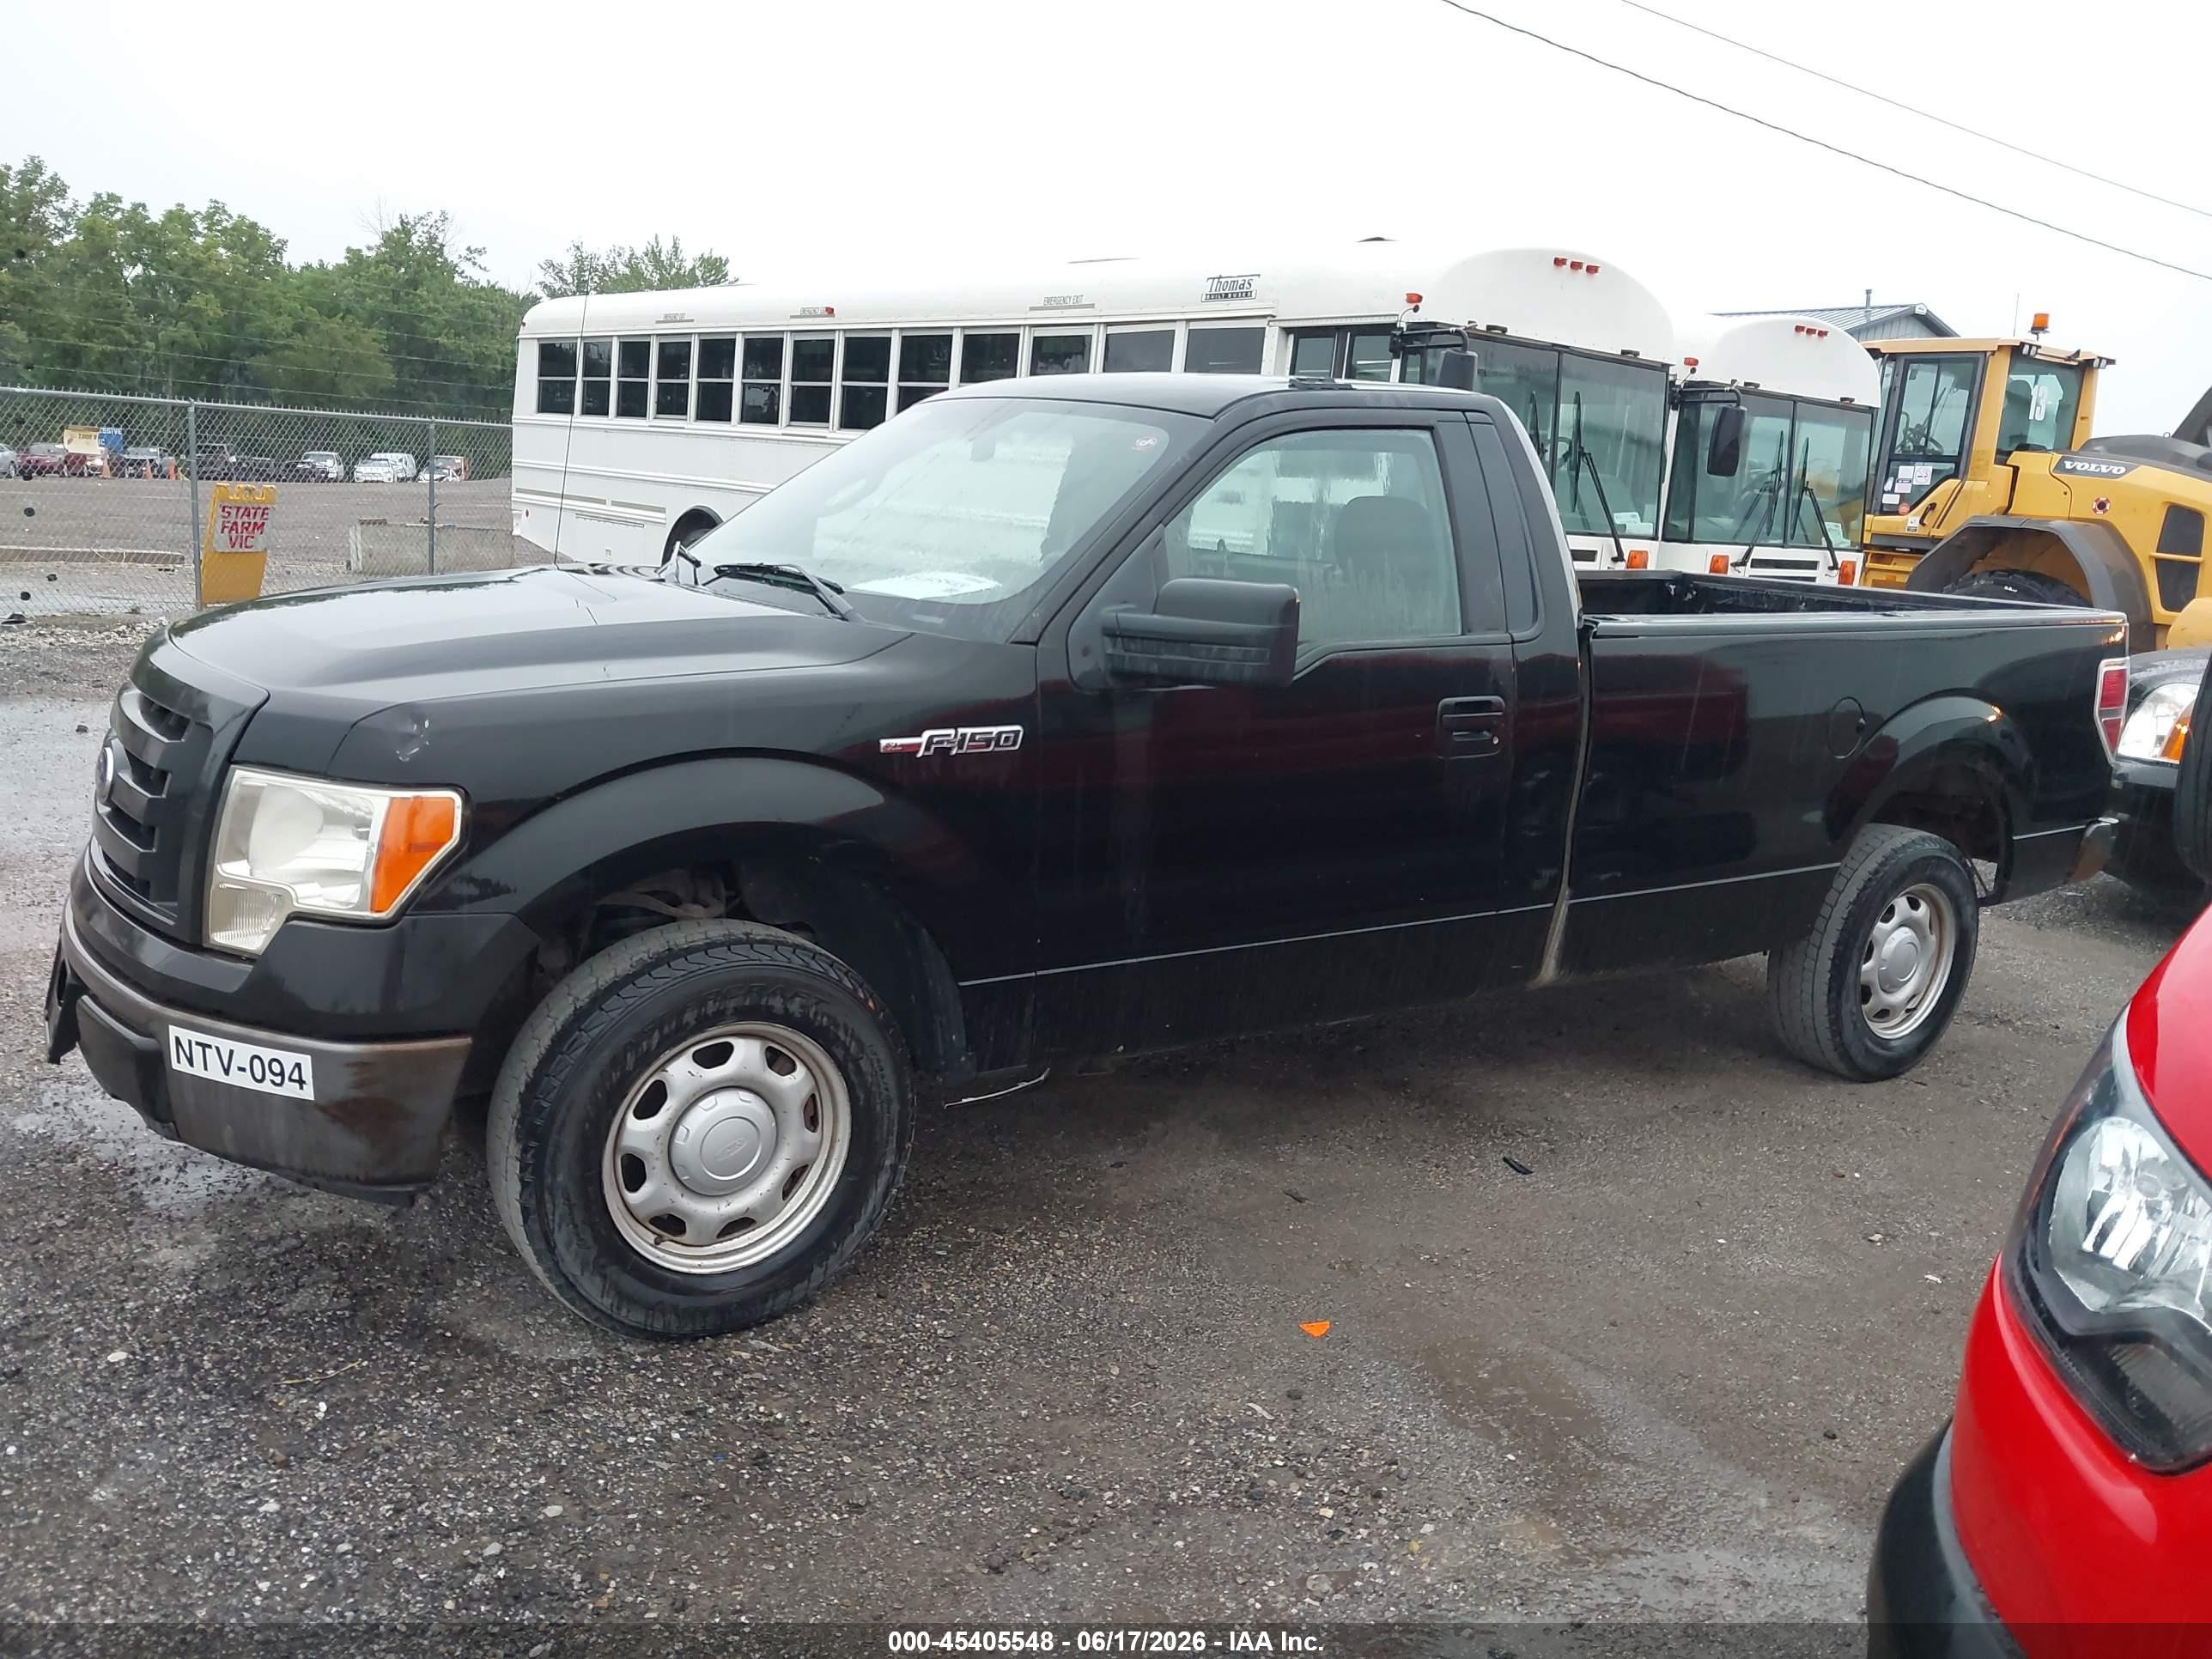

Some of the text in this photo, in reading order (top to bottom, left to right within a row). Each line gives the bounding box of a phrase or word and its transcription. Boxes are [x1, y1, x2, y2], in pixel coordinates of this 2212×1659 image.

[1206, 275, 1261, 292] Thomas
[1043, 295, 1084, 306] EMERGENCY EXIT
[2029, 385, 2048, 421] 13
[2064, 460, 2126, 474] VOLVO
[221, 505, 270, 520] STATE
[221, 520, 265, 534] FARM
[228, 536, 254, 549] VIC
[916, 724, 1024, 758] F-150
[174, 1036, 307, 1091] NTV-094
